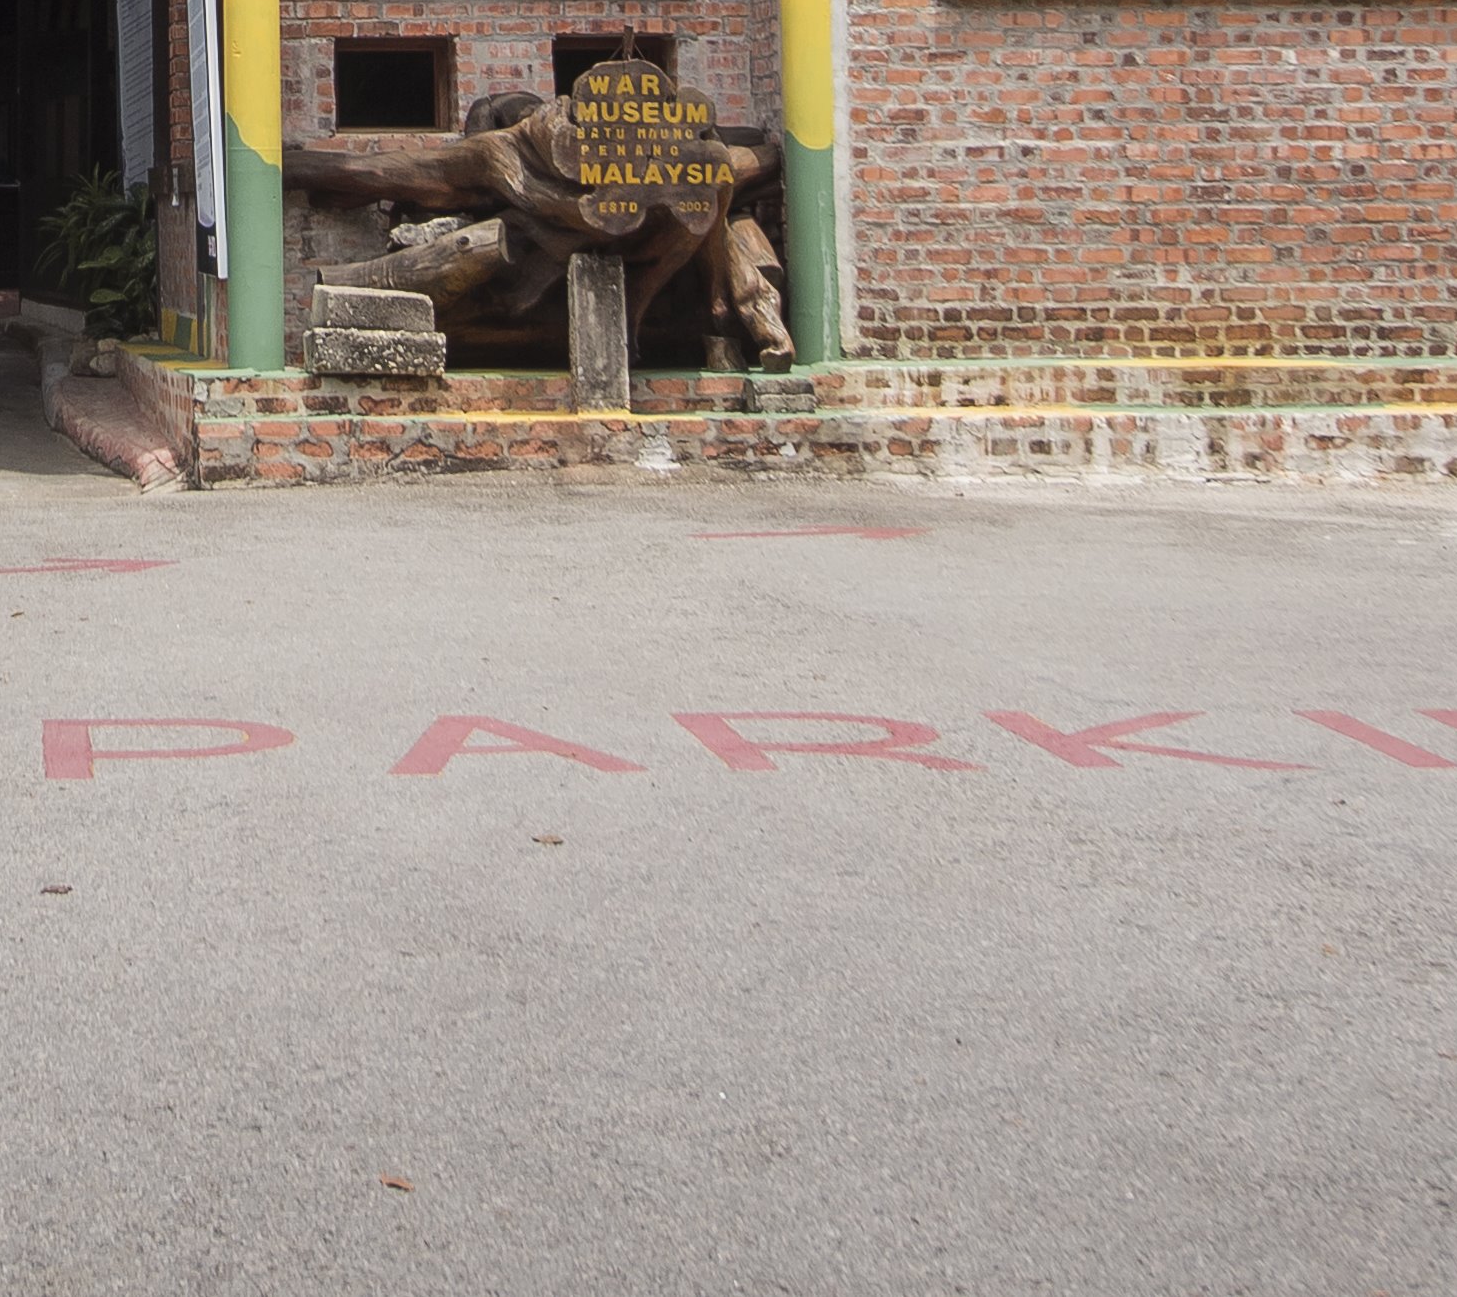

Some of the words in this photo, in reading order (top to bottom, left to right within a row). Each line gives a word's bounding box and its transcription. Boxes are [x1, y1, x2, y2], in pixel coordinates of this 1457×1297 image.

[588, 74, 661, 96] WAR
[576, 101, 708, 124] MUSEUM
[576, 127, 626, 140] BATU
[637, 127, 695, 140] MAUNG
[580, 145, 680, 157] PENANG
[579, 163, 735, 185] MALAYSIA
[598, 201, 638, 214] ESTD
[677, 201, 711, 213] 2002
